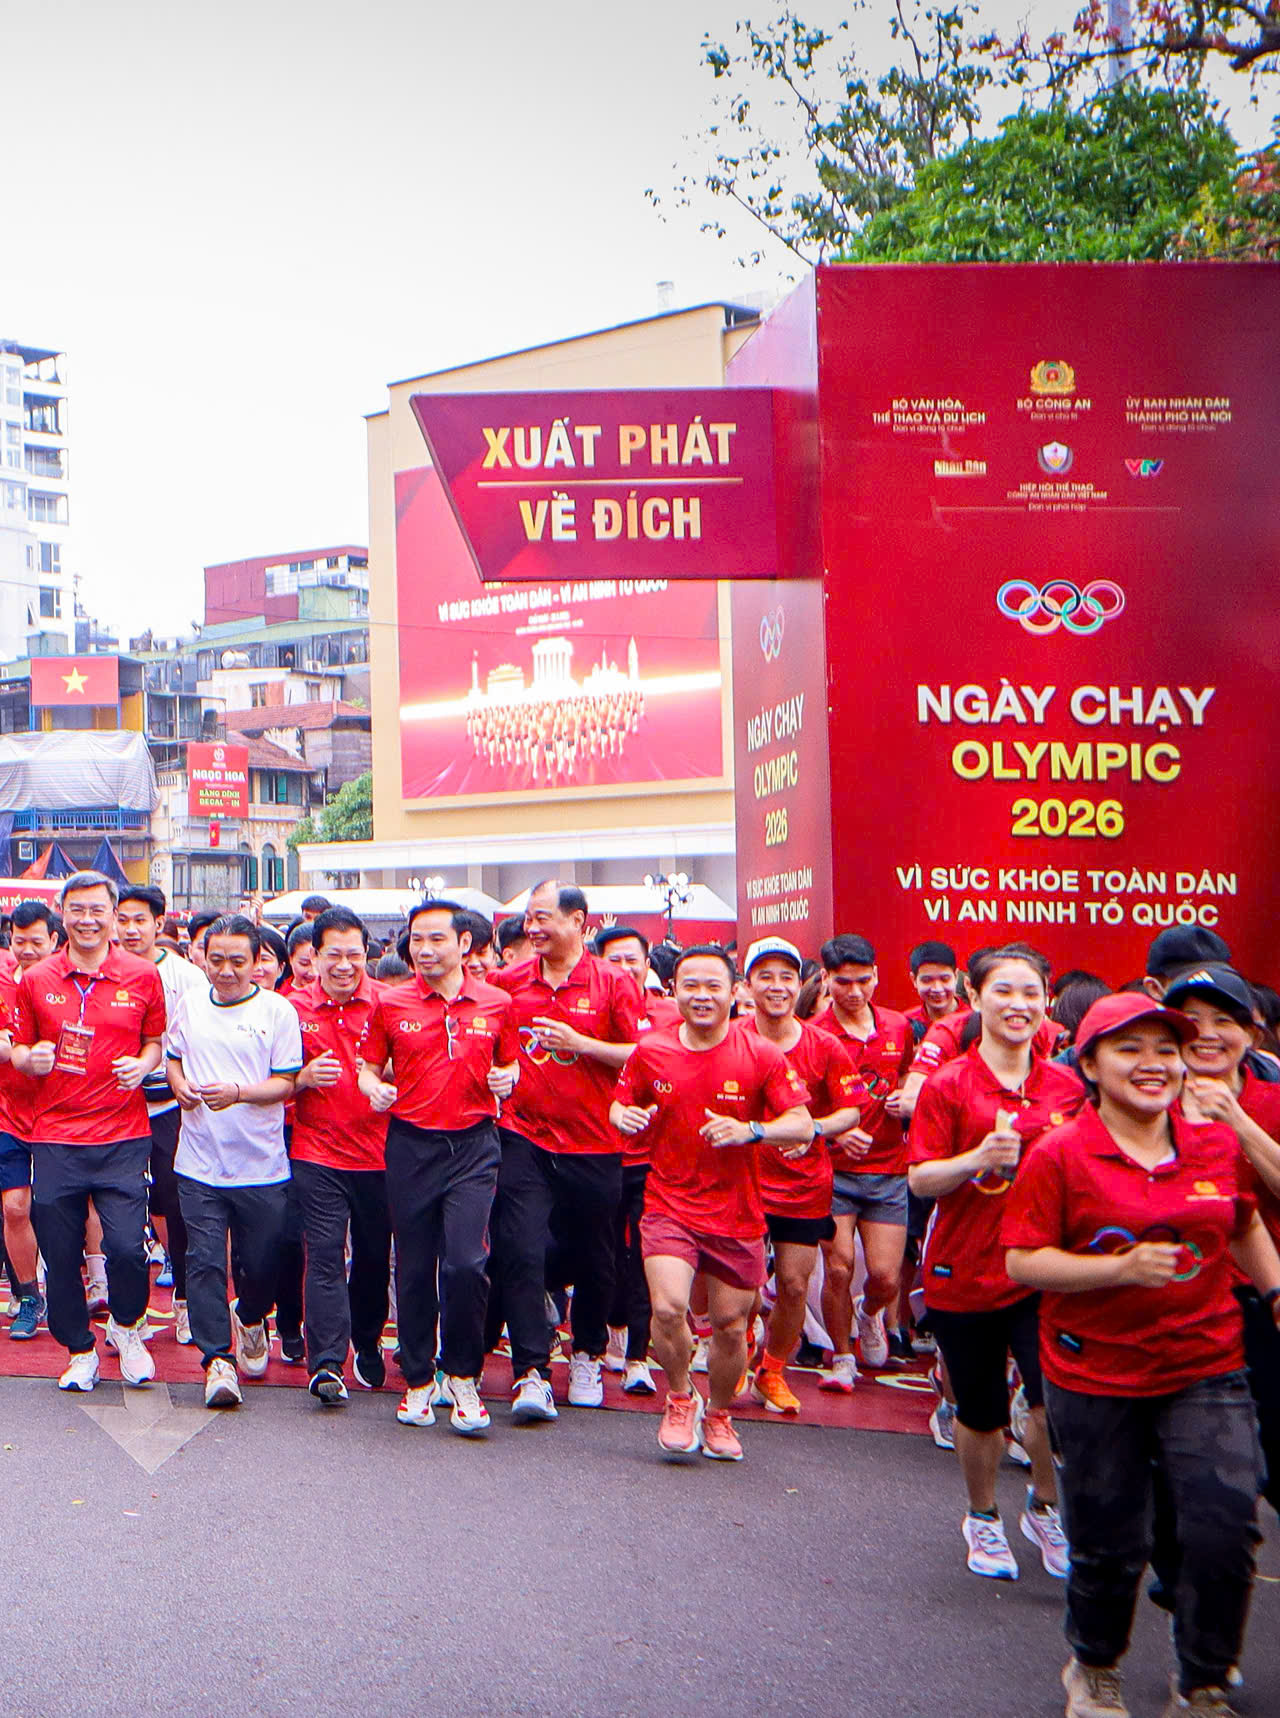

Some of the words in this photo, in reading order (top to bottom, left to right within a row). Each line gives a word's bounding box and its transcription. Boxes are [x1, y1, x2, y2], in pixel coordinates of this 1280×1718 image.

[872, 410, 890, 424] THỂ
[893, 412, 923, 423] THAO
[925, 410, 941, 423] VÀ
[943, 412, 958, 423] DU
[961, 412, 986, 424] LỊCH
[892, 397, 908, 411] BỘ
[911, 398, 934, 410] VĂN
[937, 397, 965, 411] HÓA,
[1017, 398, 1033, 411] BỘ
[1035, 398, 1072, 409] CÔNG
[1074, 398, 1091, 409] AN
[1126, 395, 1140, 409] ỦY
[1143, 398, 1167, 409] BAN
[1169, 397, 1202, 409] NHÂN
[1205, 397, 1230, 409] DÂN
[1126, 411, 1162, 422] THÀNH
[1165, 410, 1188, 422] PHỐ
[1191, 411, 1207, 422] HÀ
[1210, 410, 1232, 422] NỘI
[482, 416, 601, 469] XUẤT
[620, 416, 737, 466] PHÁT
[1124, 459, 1164, 477] VTV
[519, 491, 577, 541] VỀ
[592, 491, 702, 540] ĐÍCH
[917, 678, 1056, 725] NGÀY
[1070, 685, 1215, 733] CHẠY
[748, 706, 772, 752] NGÀY
[775, 693, 804, 740] CHẠY
[224, 771, 246, 782] HOA
[754, 750, 798, 799] OLYMPIC
[951, 741, 1180, 783] OLYMPIC
[765, 807, 788, 847] 2026
[1011, 799, 1124, 838] 2026
[896, 867, 923, 890] VÌ
[930, 865, 989, 891] SỨC
[998, 866, 1078, 893] KHỎE
[1085, 867, 1166, 894] TOÀN
[1175, 867, 1237, 896] DÂN
[924, 899, 951, 922] VÌ
[957, 900, 998, 922] AN
[1005, 901, 1077, 924] NINH
[1084, 896, 1124, 925] TỔ
[1131, 898, 1219, 928] QUỐC
